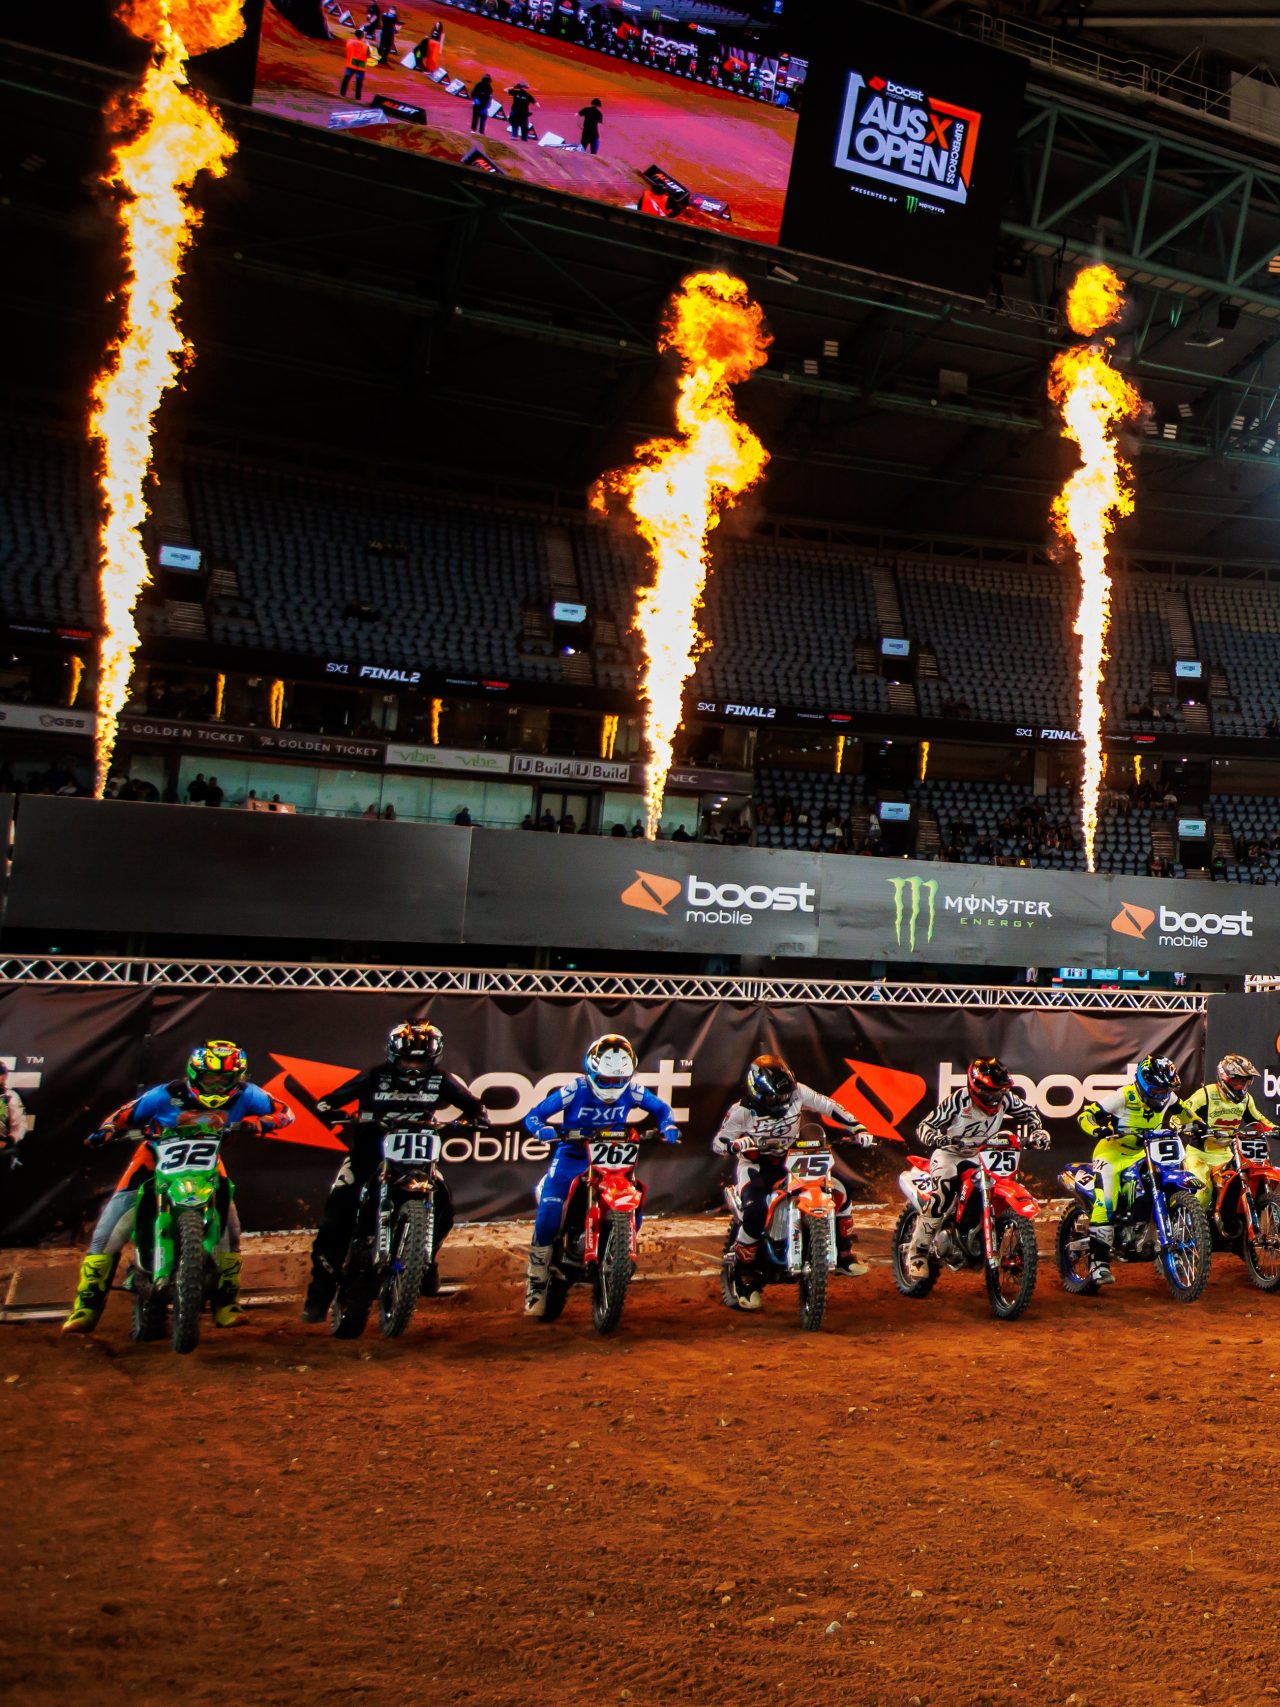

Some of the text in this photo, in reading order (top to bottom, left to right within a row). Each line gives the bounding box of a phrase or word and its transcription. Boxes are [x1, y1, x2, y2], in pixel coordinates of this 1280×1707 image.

[886, 81, 924, 102] boost
[860, 96, 953, 150] AUSX
[855, 128, 949, 182] OPEN
[946, 122, 965, 185] SUPERCROSS
[850, 186, 898, 204] PRESENTED BY
[326, 662, 349, 674] SX1
[697, 702, 716, 712] SX1
[132, 723, 192, 737] GOLDEN
[198, 729, 244, 743] TICKET
[1015, 728, 1033, 737] SX1
[278, 737, 330, 752] GOLDEN
[335, 744, 379, 757] TICKET
[535, 758, 570, 776] Build
[592, 765, 628, 780] Build
[669, 773, 698, 784] NEC
[687, 874, 815, 914] boost
[944, 894, 1052, 918] MONSTER
[685, 909, 753, 925] mobile
[959, 917, 1035, 929] ENERGY
[1159, 905, 1253, 937] boost
[1158, 934, 1208, 948] mobile
[165, 1142, 217, 1169] 32
[393, 1134, 434, 1160] 49
[440, 1131, 551, 1162] obile
[592, 1143, 638, 1165] 262
[1159, 1141, 1180, 1162] 9
[1241, 1141, 1268, 1159] 52
[791, 1156, 830, 1177] 45
[988, 1152, 1016, 1172] 25
